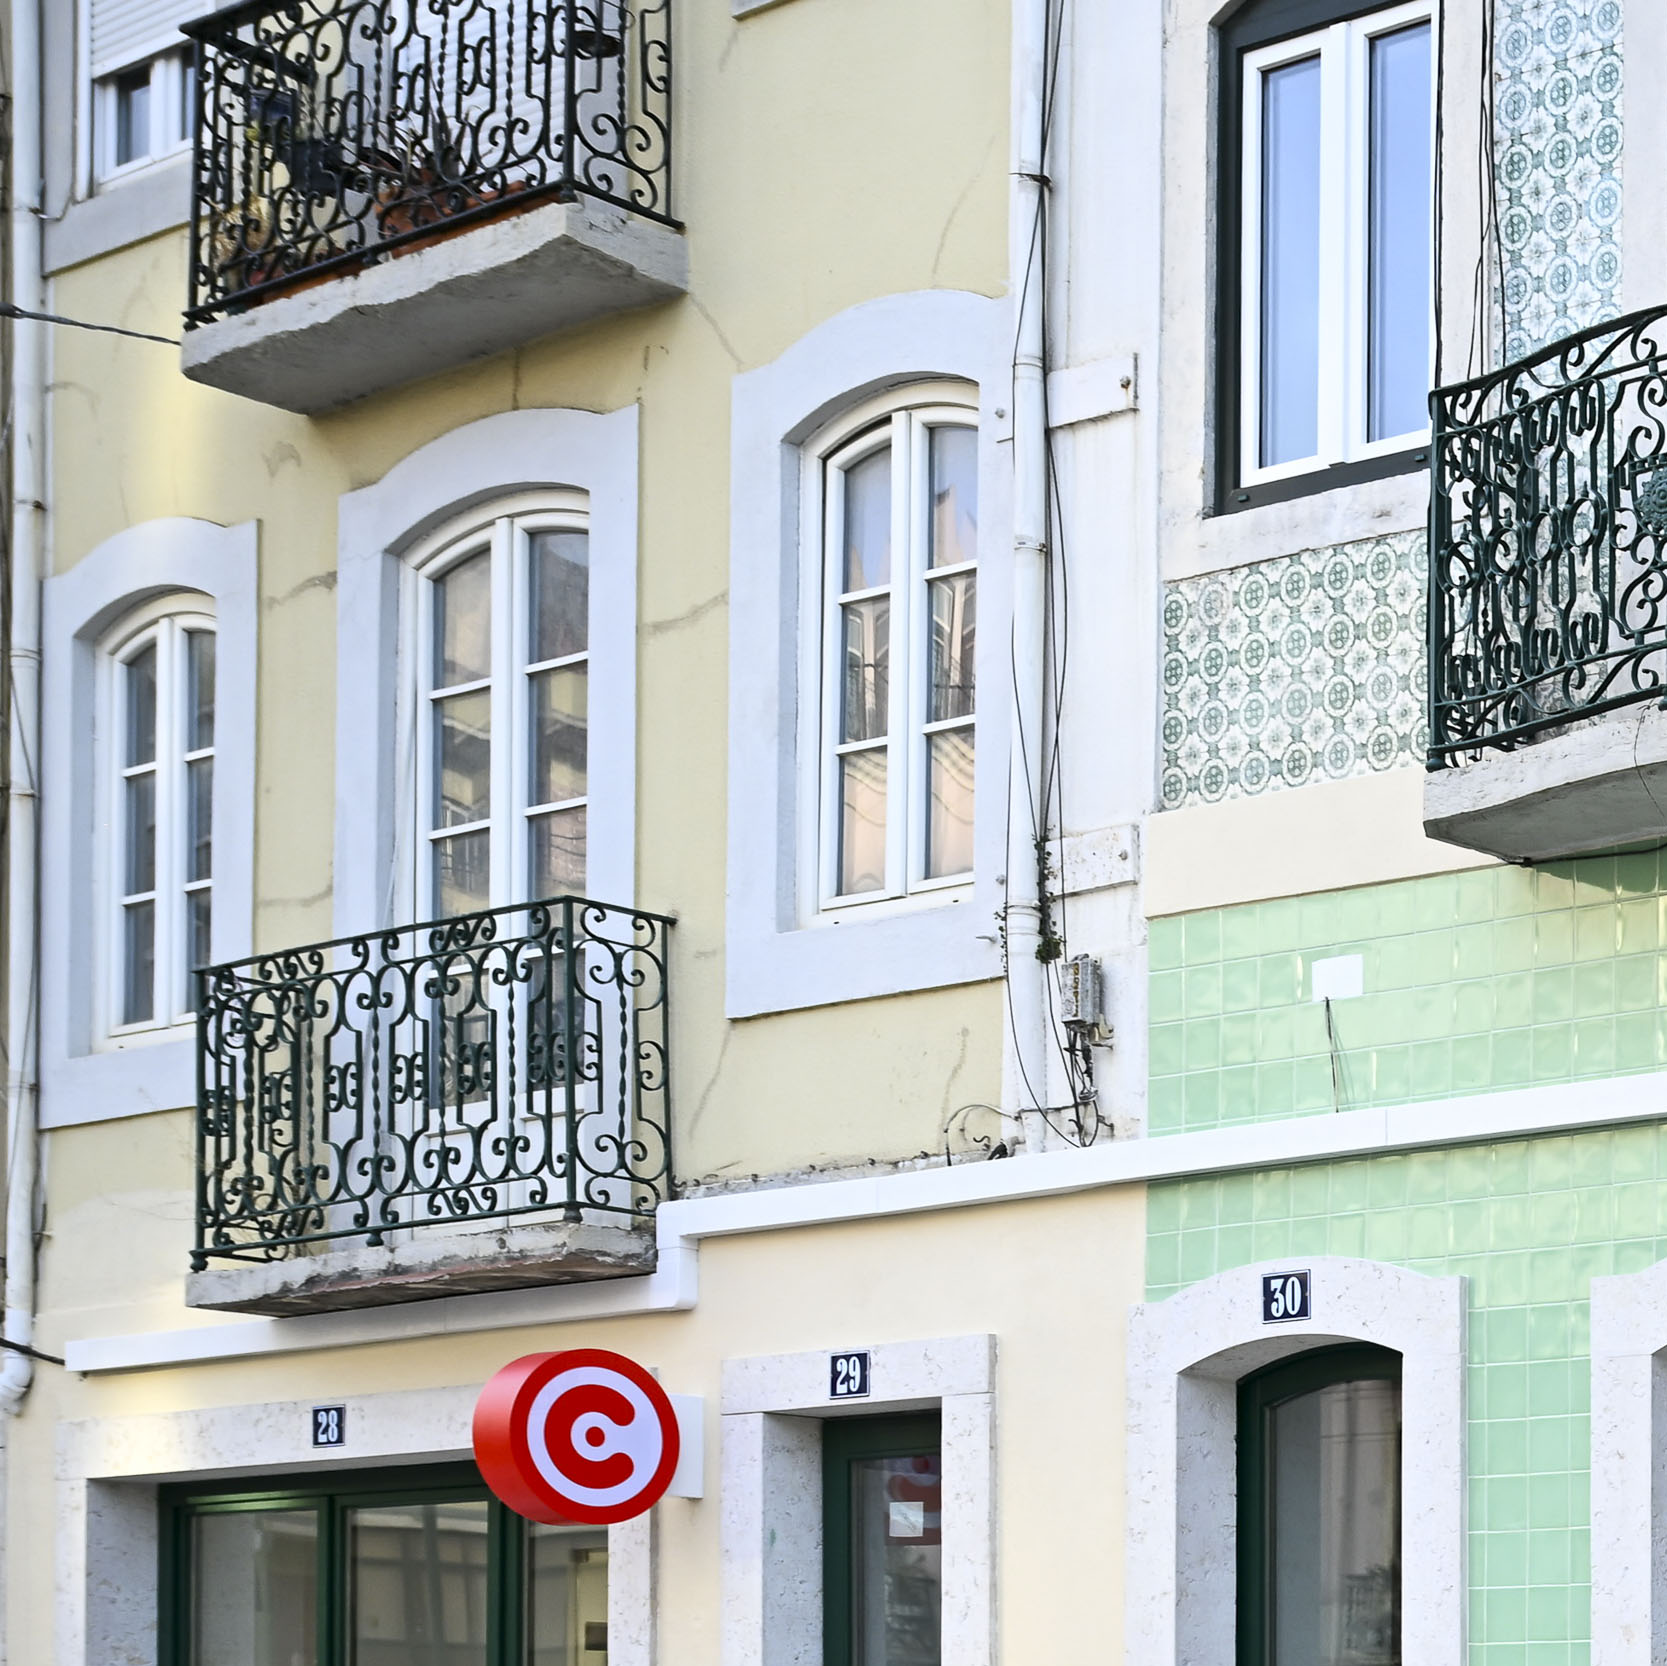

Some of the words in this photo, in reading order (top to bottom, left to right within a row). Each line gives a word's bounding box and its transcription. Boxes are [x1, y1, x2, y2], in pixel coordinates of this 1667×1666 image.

[1270, 1276, 1302, 1318] 30
[836, 1355, 862, 1395] 29
[317, 1409, 339, 1443] 28
